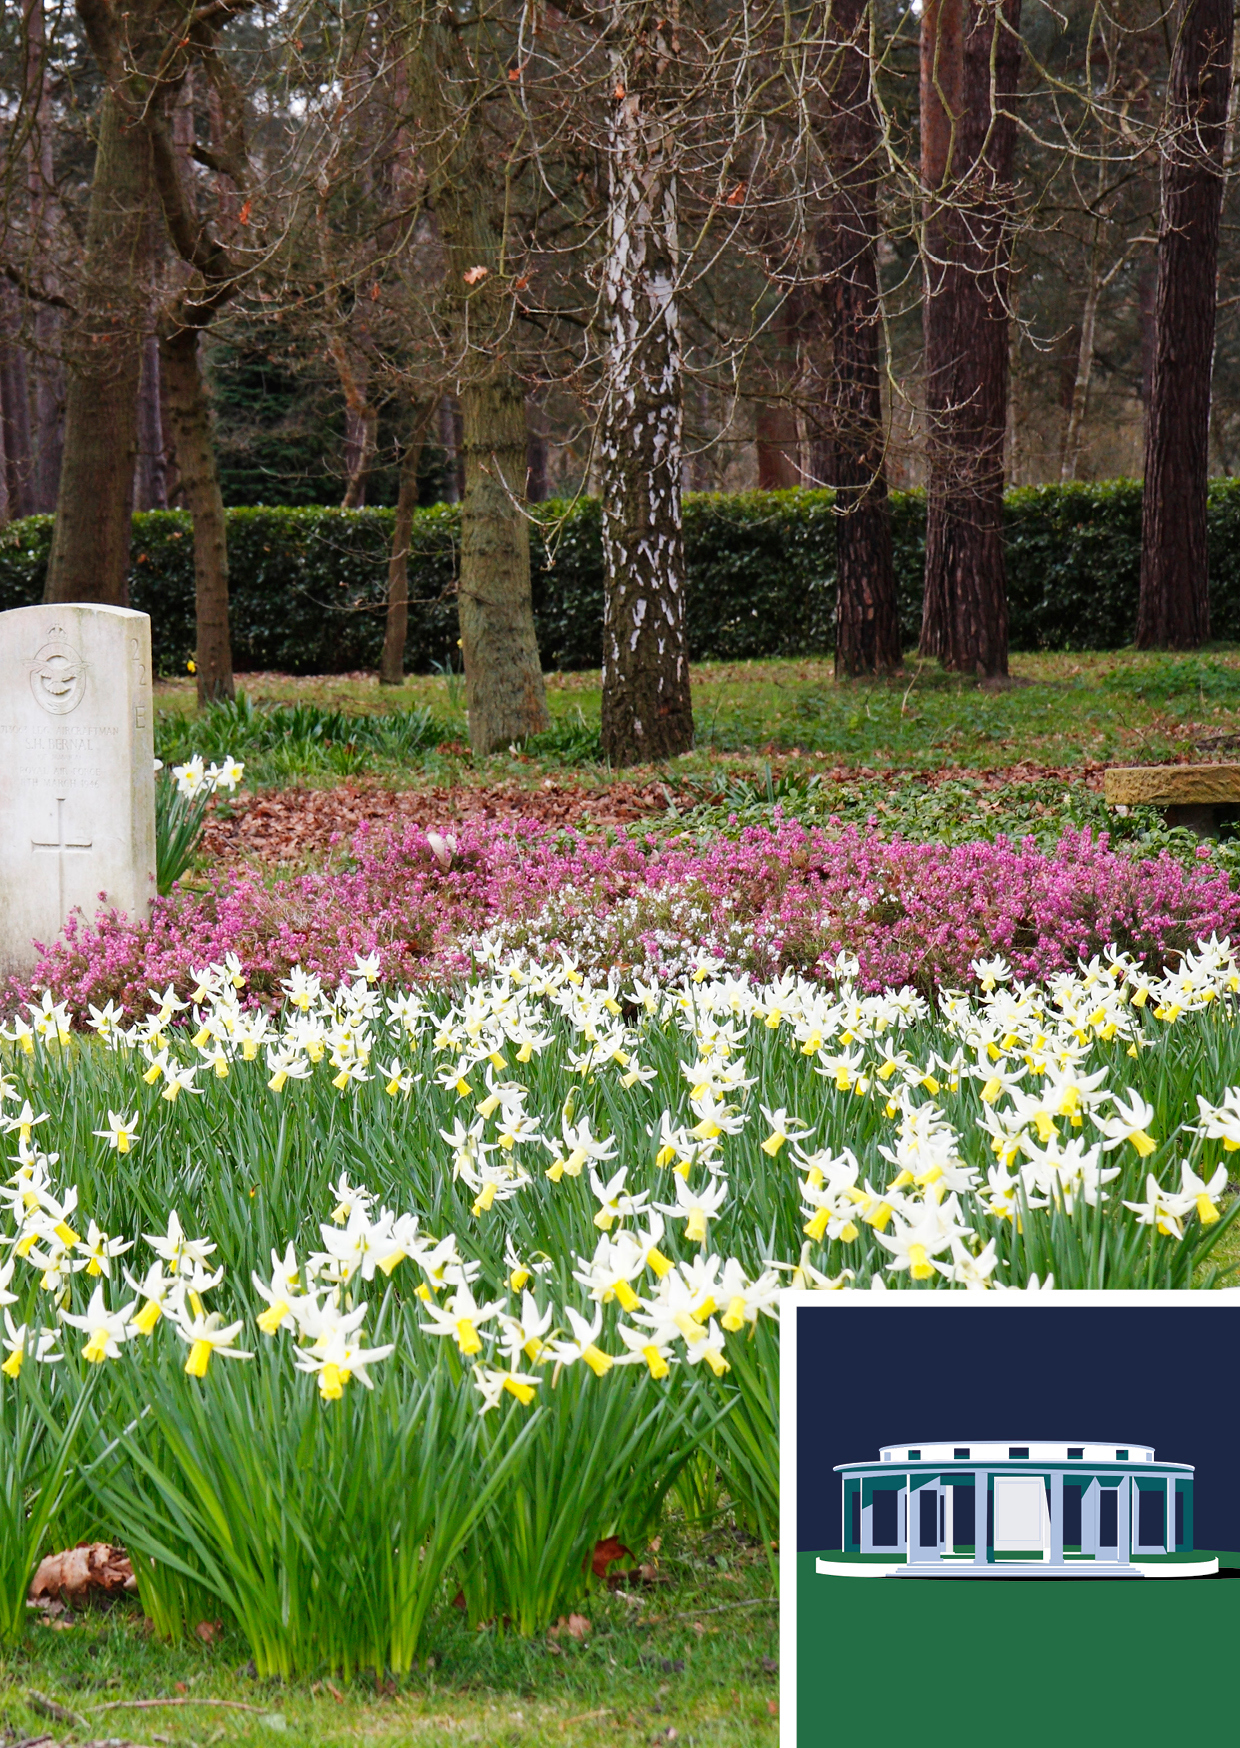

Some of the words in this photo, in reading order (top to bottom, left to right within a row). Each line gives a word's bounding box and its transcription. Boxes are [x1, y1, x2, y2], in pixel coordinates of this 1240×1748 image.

[134, 705, 146, 729] E
[55, 726, 120, 736] AIRCRAFTMAN
[48, 738, 94, 751] BERNAL
[53, 766, 68, 776] AIR
[43, 778, 77, 788] MARCH
